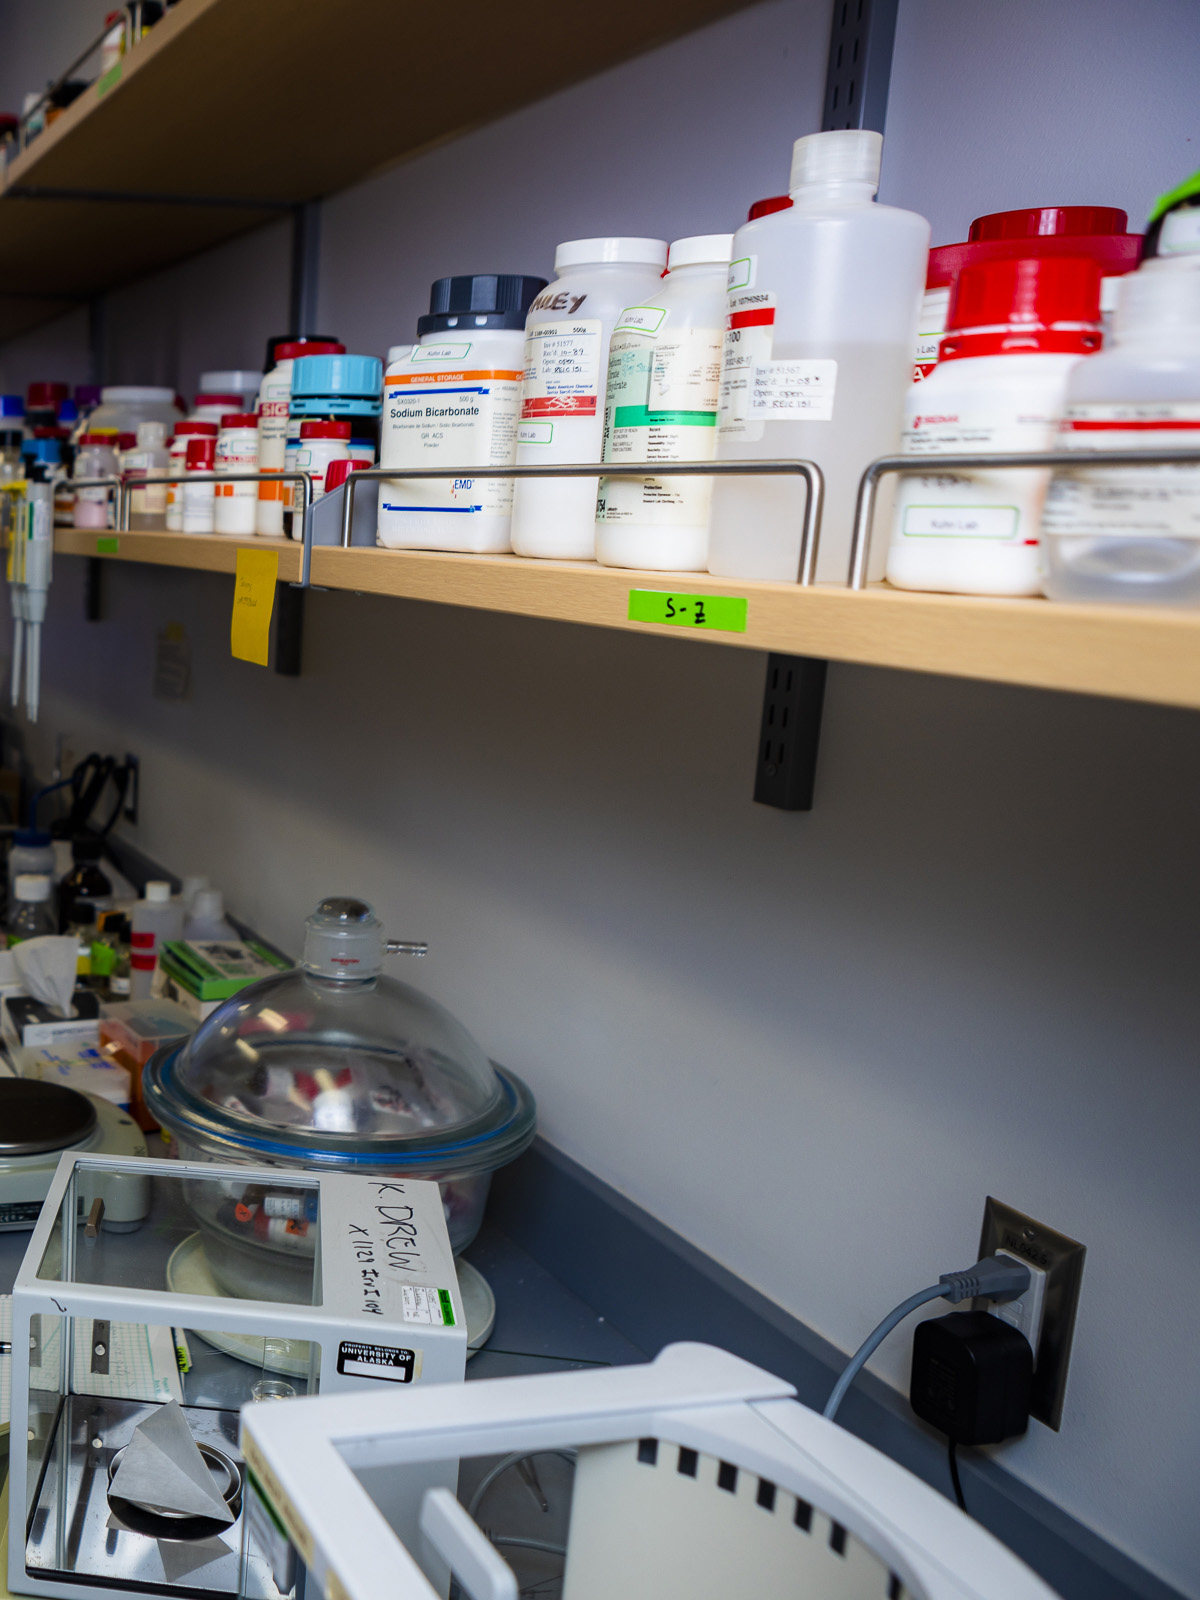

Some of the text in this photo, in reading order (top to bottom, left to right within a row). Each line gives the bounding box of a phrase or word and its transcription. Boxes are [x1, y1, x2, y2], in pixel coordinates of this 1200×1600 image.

[410, 374, 464, 383] GENERAL STORAGE
[261, 403, 289, 417] SIG
[390, 406, 479, 418] Sodium Bicarbonate
[454, 479, 472, 490] EMD
[375, 1205, 421, 1272] DREW
[341, 1346, 411, 1362] UNIVERSITY OF
[344, 1342, 372, 1350] PROPERTY
[374, 1346, 400, 1354] BELONGS
[357, 1355, 394, 1366] ALASKA
